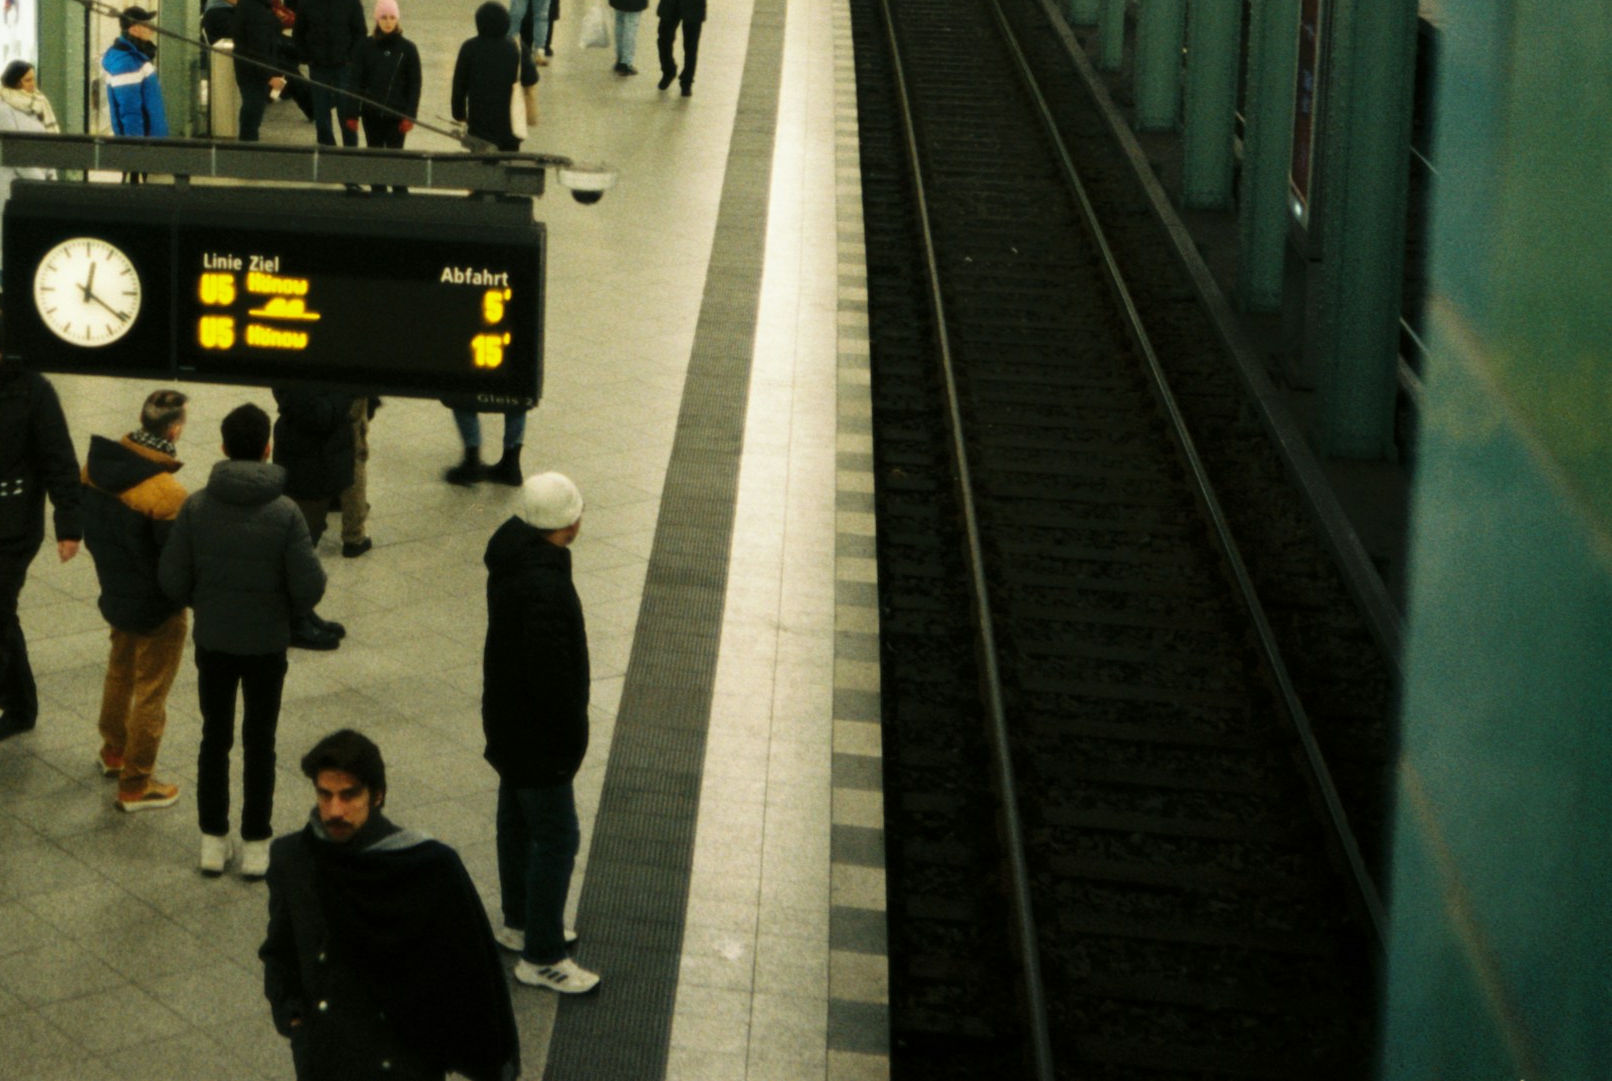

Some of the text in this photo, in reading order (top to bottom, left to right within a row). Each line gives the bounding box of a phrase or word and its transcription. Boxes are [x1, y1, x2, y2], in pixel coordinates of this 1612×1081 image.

[203, 252, 509, 286] Linie Ziel Abfahrt
[199, 271, 236, 306] U5
[199, 314, 236, 350] U5
[477, 394, 520, 405] Gleis
